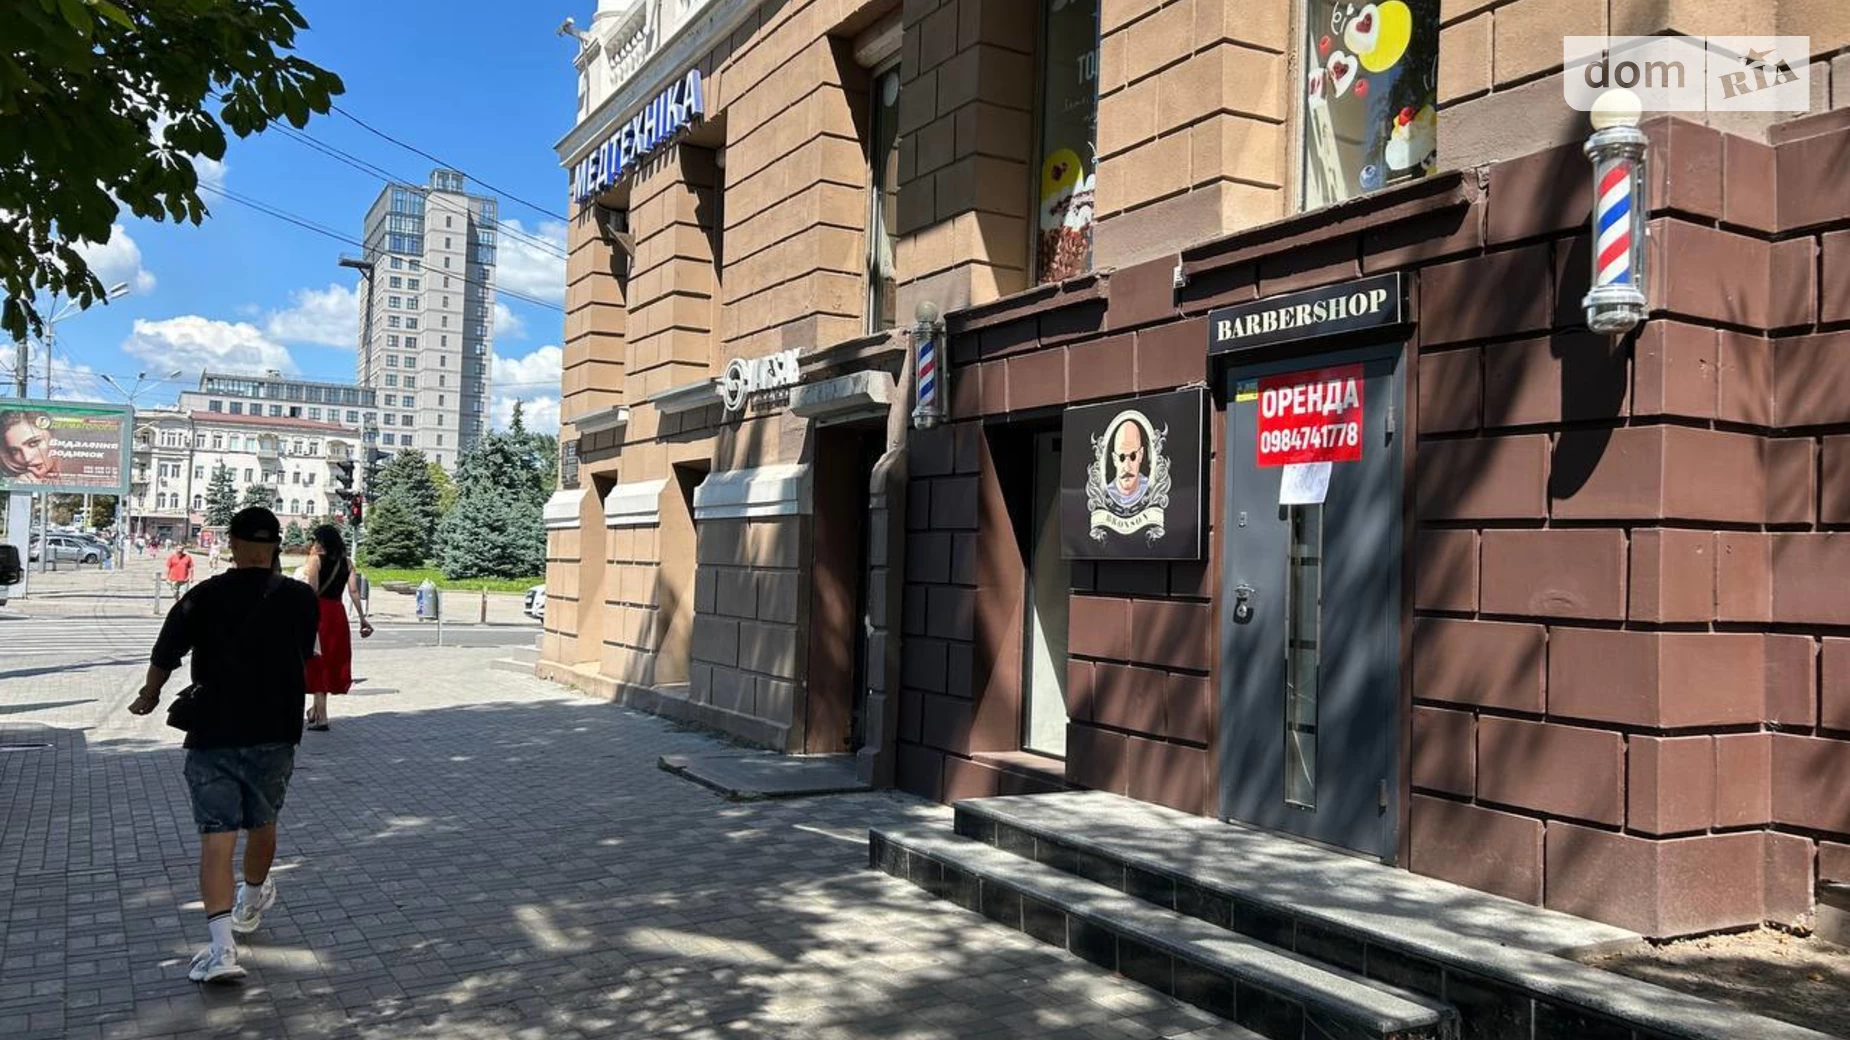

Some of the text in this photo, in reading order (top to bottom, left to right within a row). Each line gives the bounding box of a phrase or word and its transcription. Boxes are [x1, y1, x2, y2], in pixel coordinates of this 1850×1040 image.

[573, 68, 703, 203] МЕДТЕХНІКА
[1217, 288, 1387, 341] BARBERSHOP
[1262, 378, 1359, 418] ОРЕНДА
[48, 449, 104, 458] родимок
[49, 438, 118, 450] Видалення
[1260, 421, 1358, 453] 0984741778
